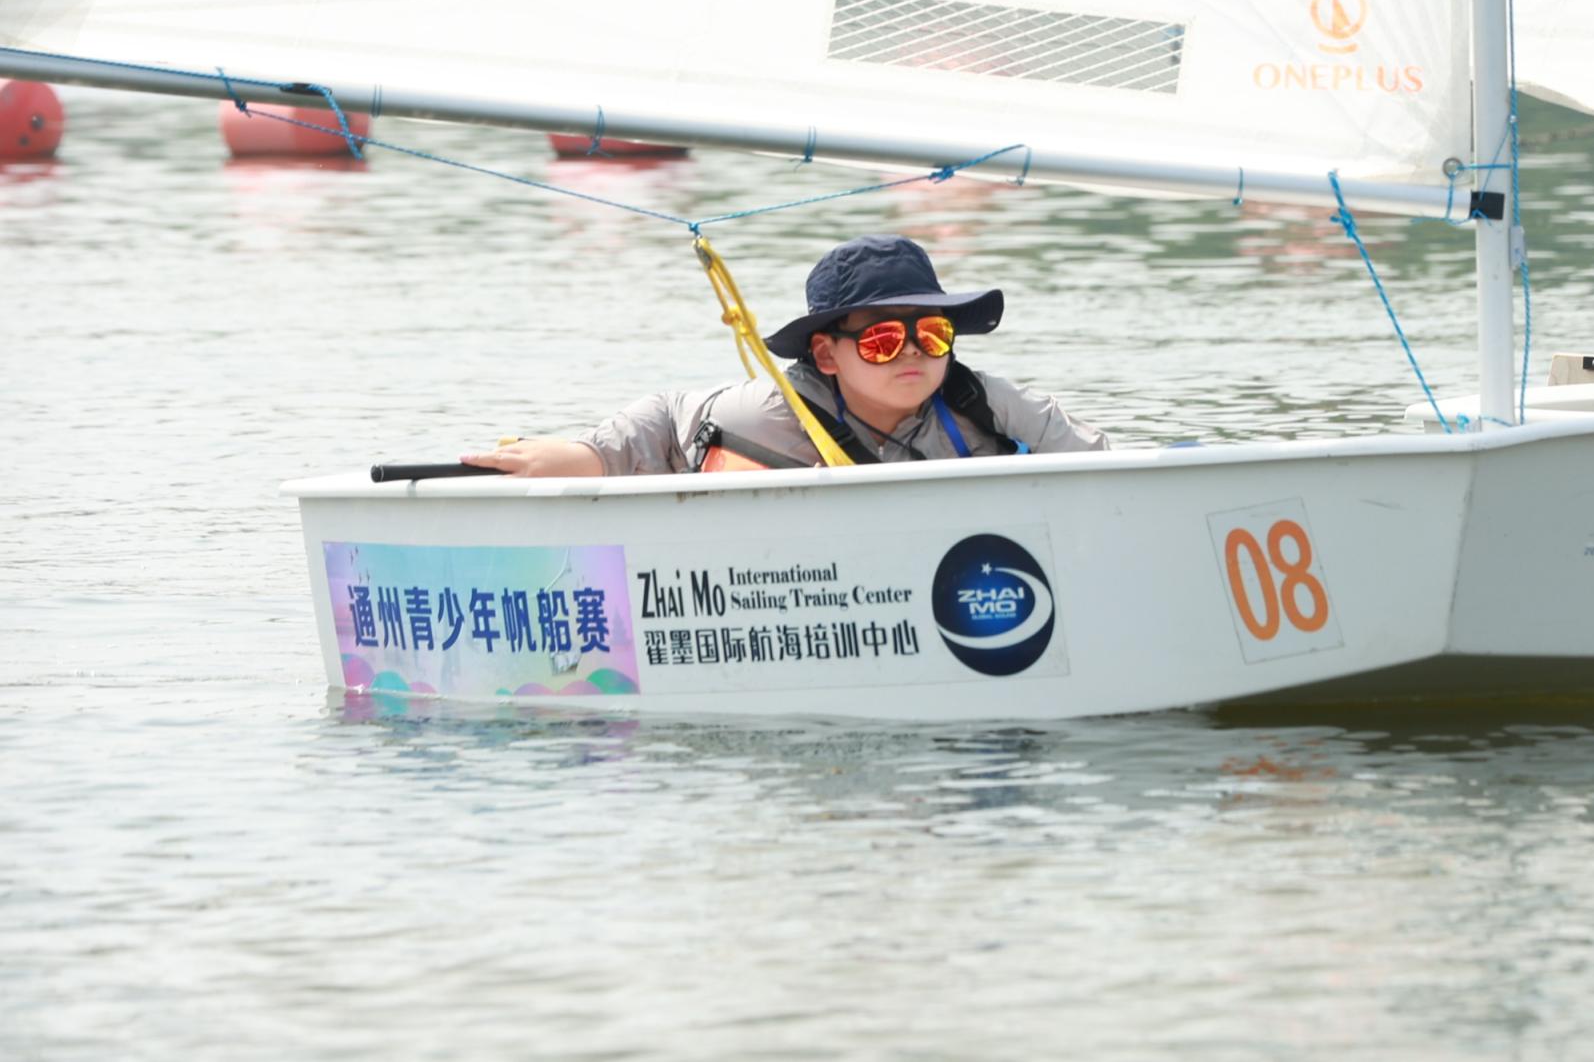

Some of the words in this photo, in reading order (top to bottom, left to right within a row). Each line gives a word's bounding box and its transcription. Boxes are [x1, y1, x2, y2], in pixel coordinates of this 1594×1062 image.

[1253, 62, 1423, 93] ONEPLUS
[728, 562, 838, 586] International
[1225, 519, 1329, 641] 08
[730, 589, 787, 613] Sailing
[790, 587, 848, 610] Traing
[852, 585, 912, 605] Center
[957, 586, 1025, 603] ZHAI
[968, 599, 1017, 614] MO
[347, 584, 610, 653] 通州青少年帆船赛
[644, 619, 920, 666] 翟墨国际航海培训中心
